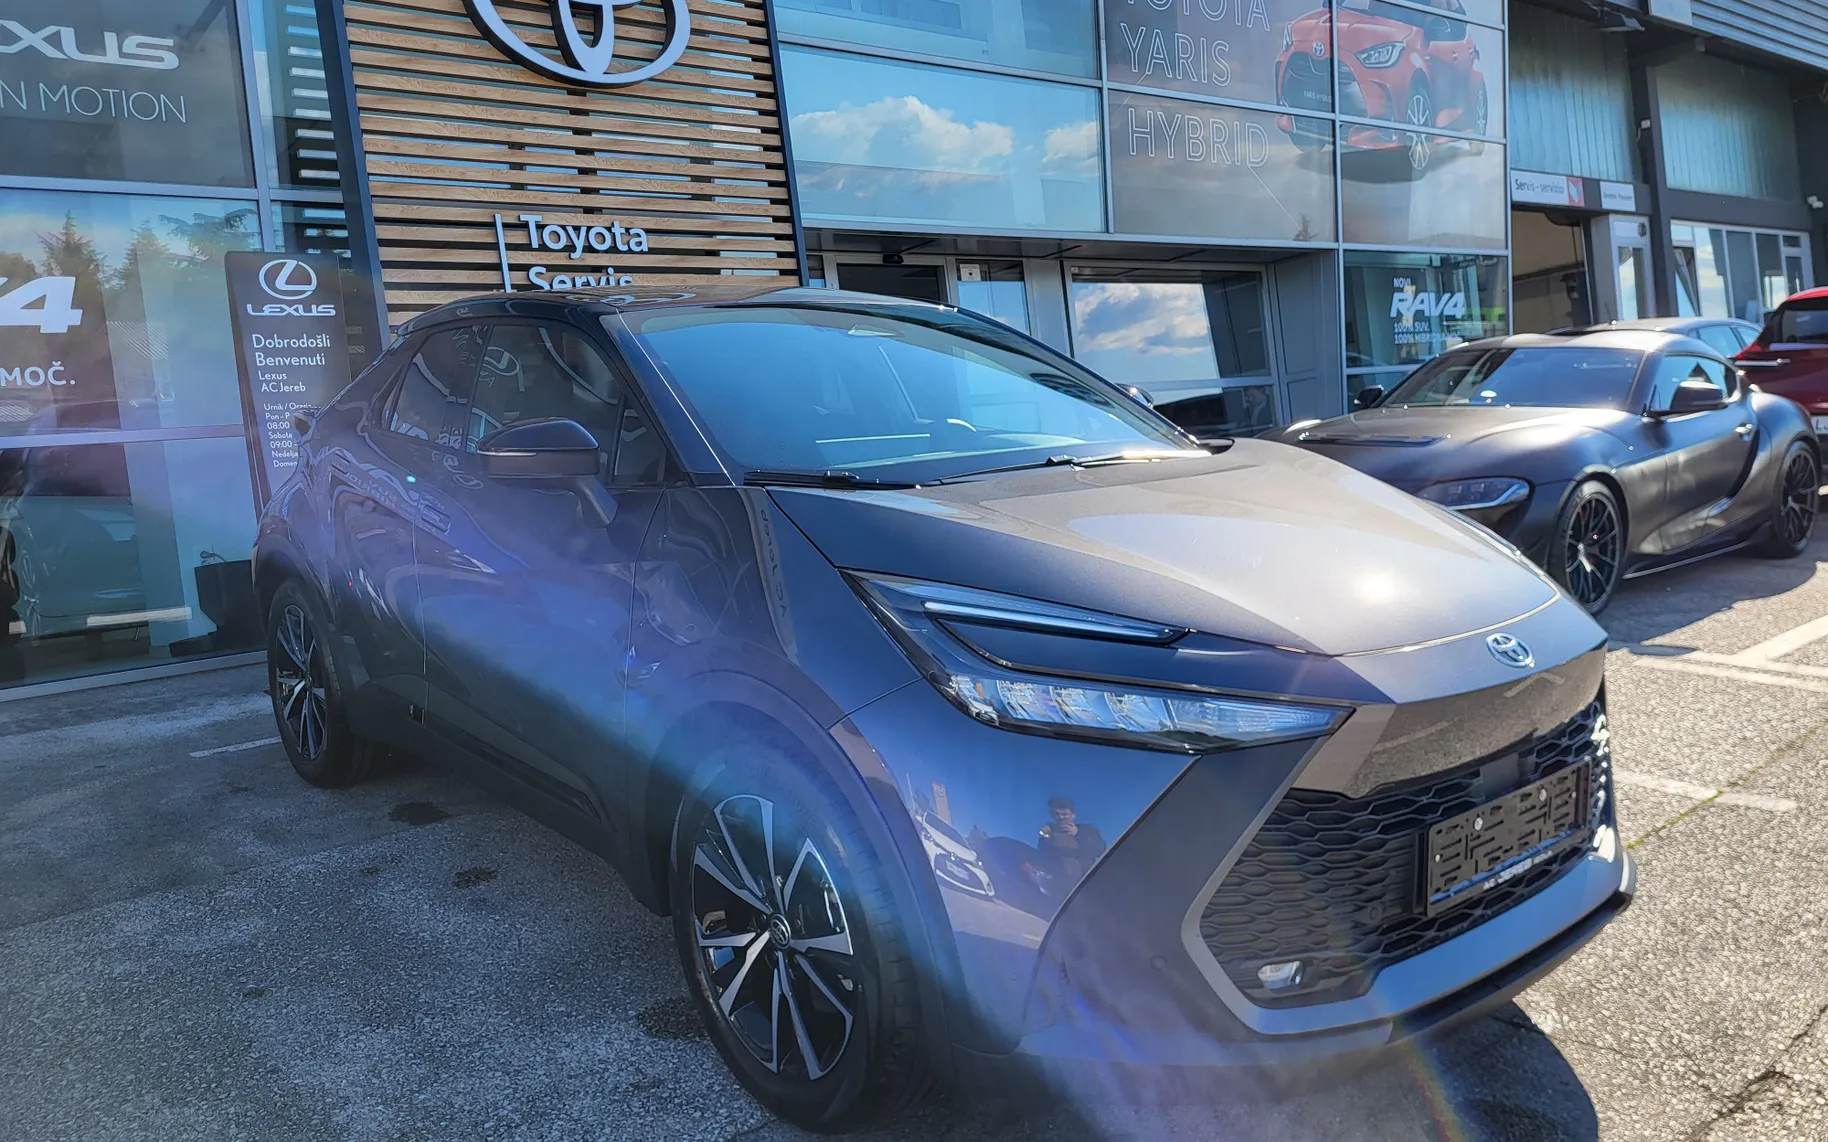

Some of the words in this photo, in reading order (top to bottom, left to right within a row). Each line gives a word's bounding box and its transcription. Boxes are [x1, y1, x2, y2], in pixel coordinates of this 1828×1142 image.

[0, 19, 180, 70] XUS
[1120, 22, 1232, 87] YARIS
[38, 82, 188, 124] MOTION
[1127, 107, 1269, 169] HYBRID
[519, 213, 649, 260] Toyota
[0, 276, 83, 333] 4
[247, 304, 335, 316] LEXUS
[1390, 291, 1465, 319] RAV4
[252, 333, 331, 349] Dobrodošli
[255, 353, 326, 367] Benvenuti
[0, 360, 76, 387] MOČ.
[258, 370, 288, 381] Lexus
[261, 383, 278, 393] AC
[279, 383, 306, 393] Jereb
[263, 402, 283, 411] Urnik
[265, 412, 280, 420] Pon
[266, 422, 290, 430] 08:00
[268, 431, 293, 439] Sobota
[271, 450, 298, 459] Nedelja
[273, 460, 298, 468] Domen
